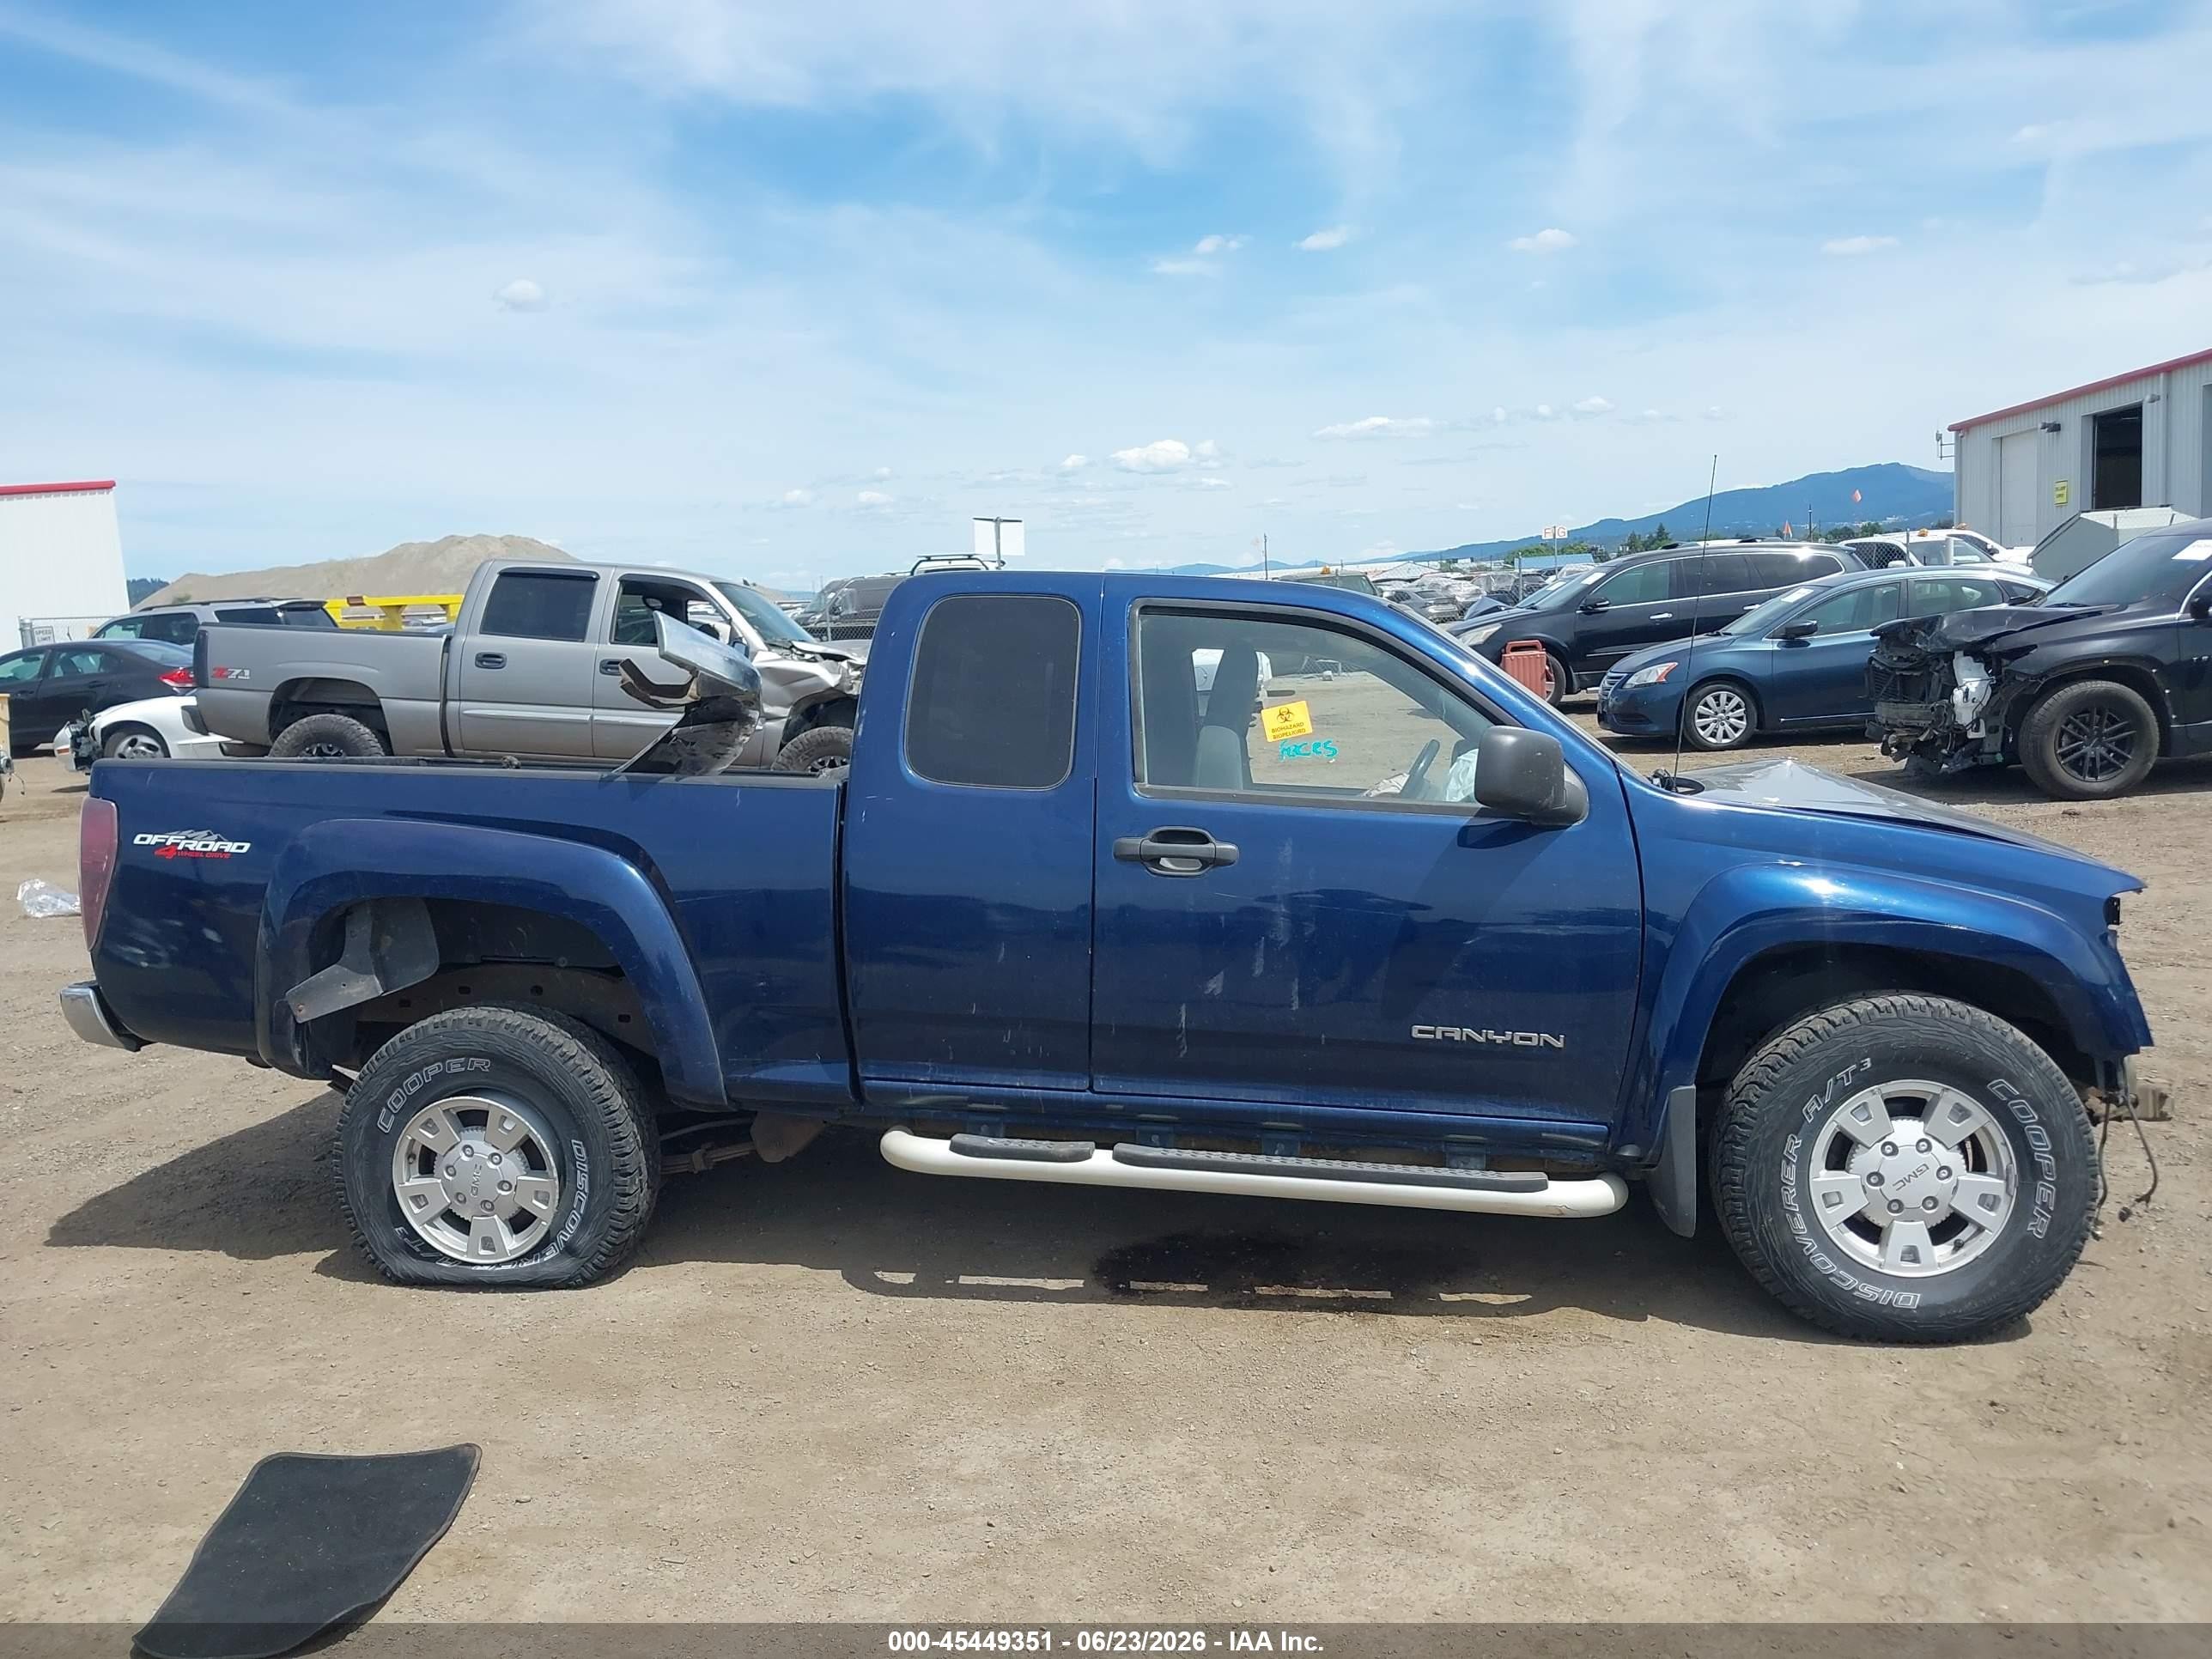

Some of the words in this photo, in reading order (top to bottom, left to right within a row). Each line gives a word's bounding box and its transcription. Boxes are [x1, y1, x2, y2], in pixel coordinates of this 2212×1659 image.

[213, 666, 250, 679] Z71
[1272, 722, 1304, 733] BIOHAZARD
[133, 834, 251, 854] OFFROAD
[155, 845, 177, 859] 4
[1411, 1025, 1565, 1048] CANYON
[377, 1057, 491, 1133] COOPER
[1986, 1079, 2057, 1239] COOPER
[470, 1164, 483, 1197] GMC
[1892, 1163, 1930, 1192] GMC
[1780, 1133, 1922, 1310] DISCOVERER
